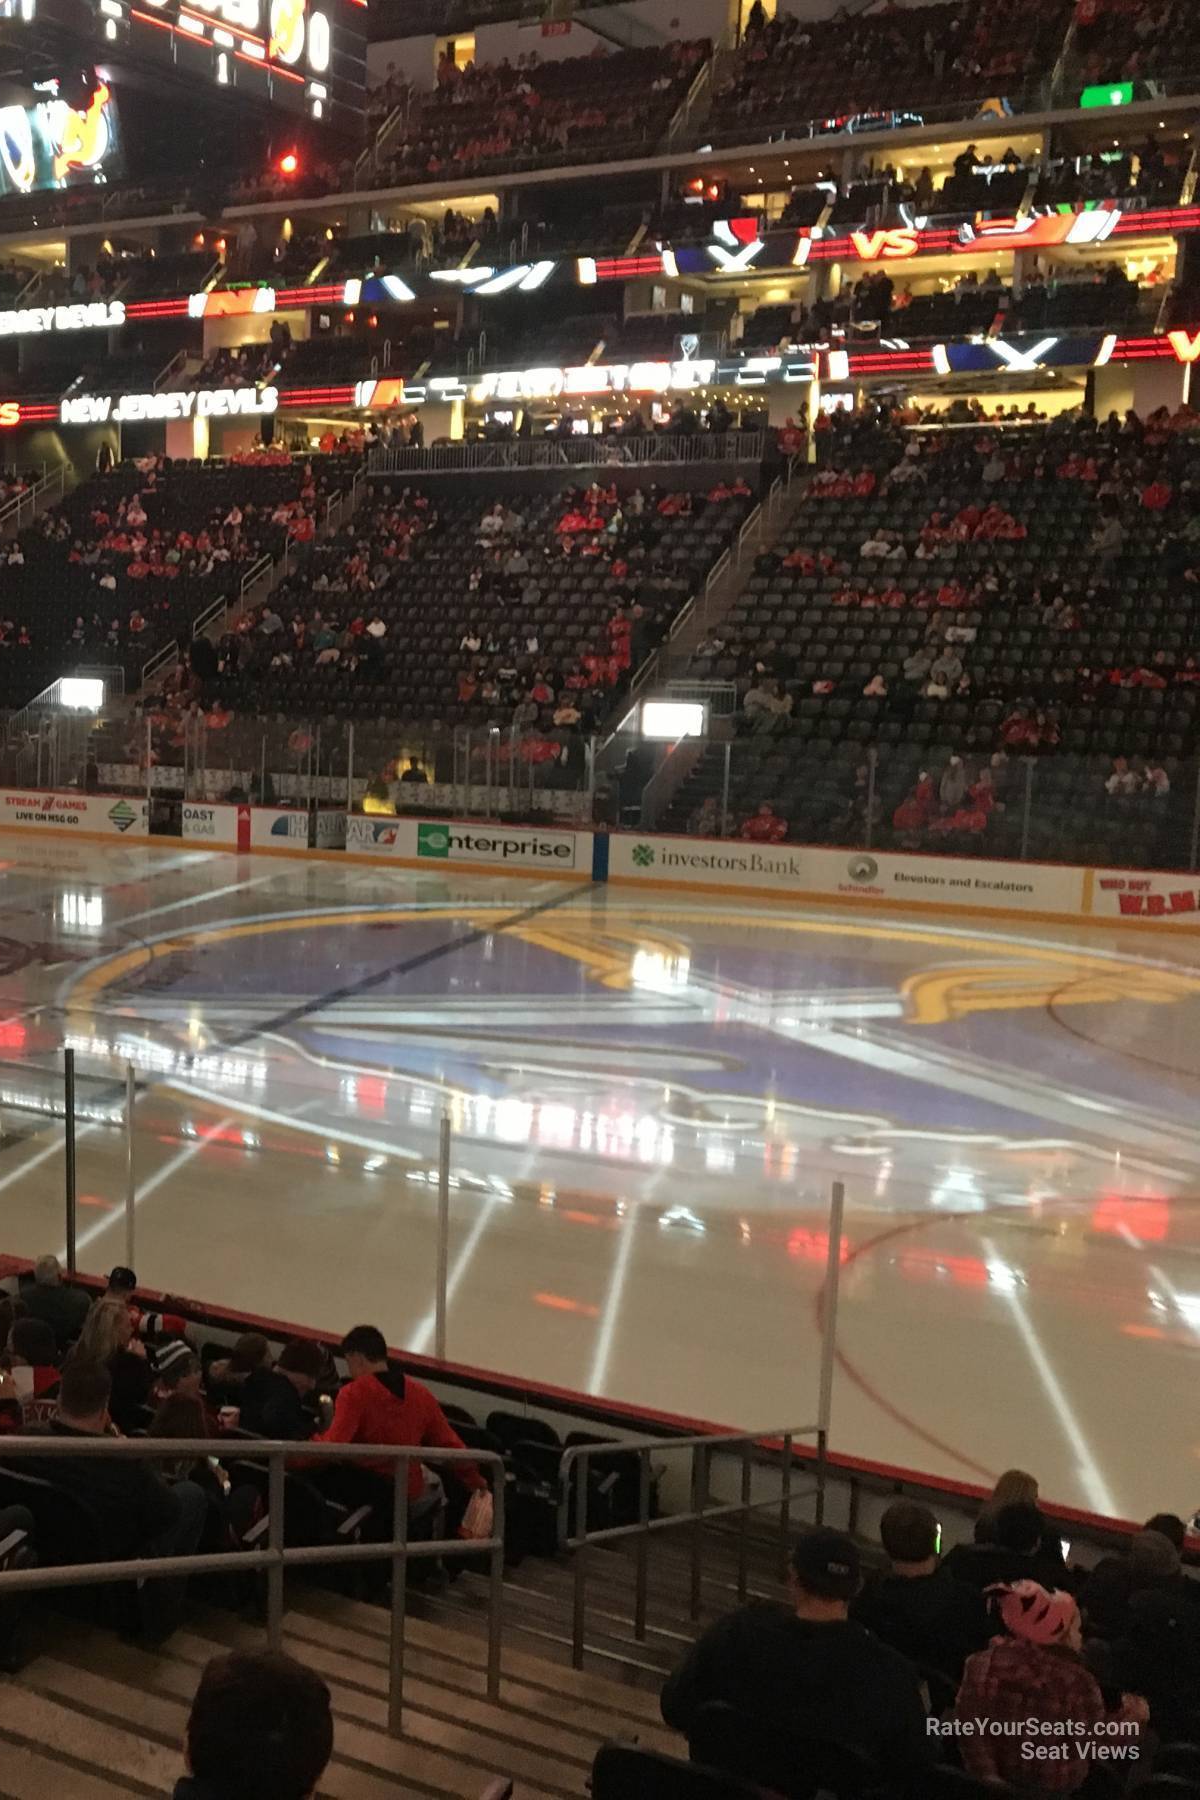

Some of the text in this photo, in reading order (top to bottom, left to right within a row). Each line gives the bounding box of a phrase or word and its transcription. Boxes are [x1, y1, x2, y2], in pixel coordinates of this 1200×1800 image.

[852, 229, 918, 259] VS
[56, 300, 126, 331] DEVILS
[1168, 330, 1200, 363] V
[60, 396, 112, 424] NEW
[112, 391, 197, 422] JERSEY
[197, 386, 279, 416] DEVILS
[16, 811, 34, 821] LIVE
[35, 812, 47, 821] ON
[56, 800, 88, 812] GAMES
[894, 871, 1034, 893] Elevators and Escalators
